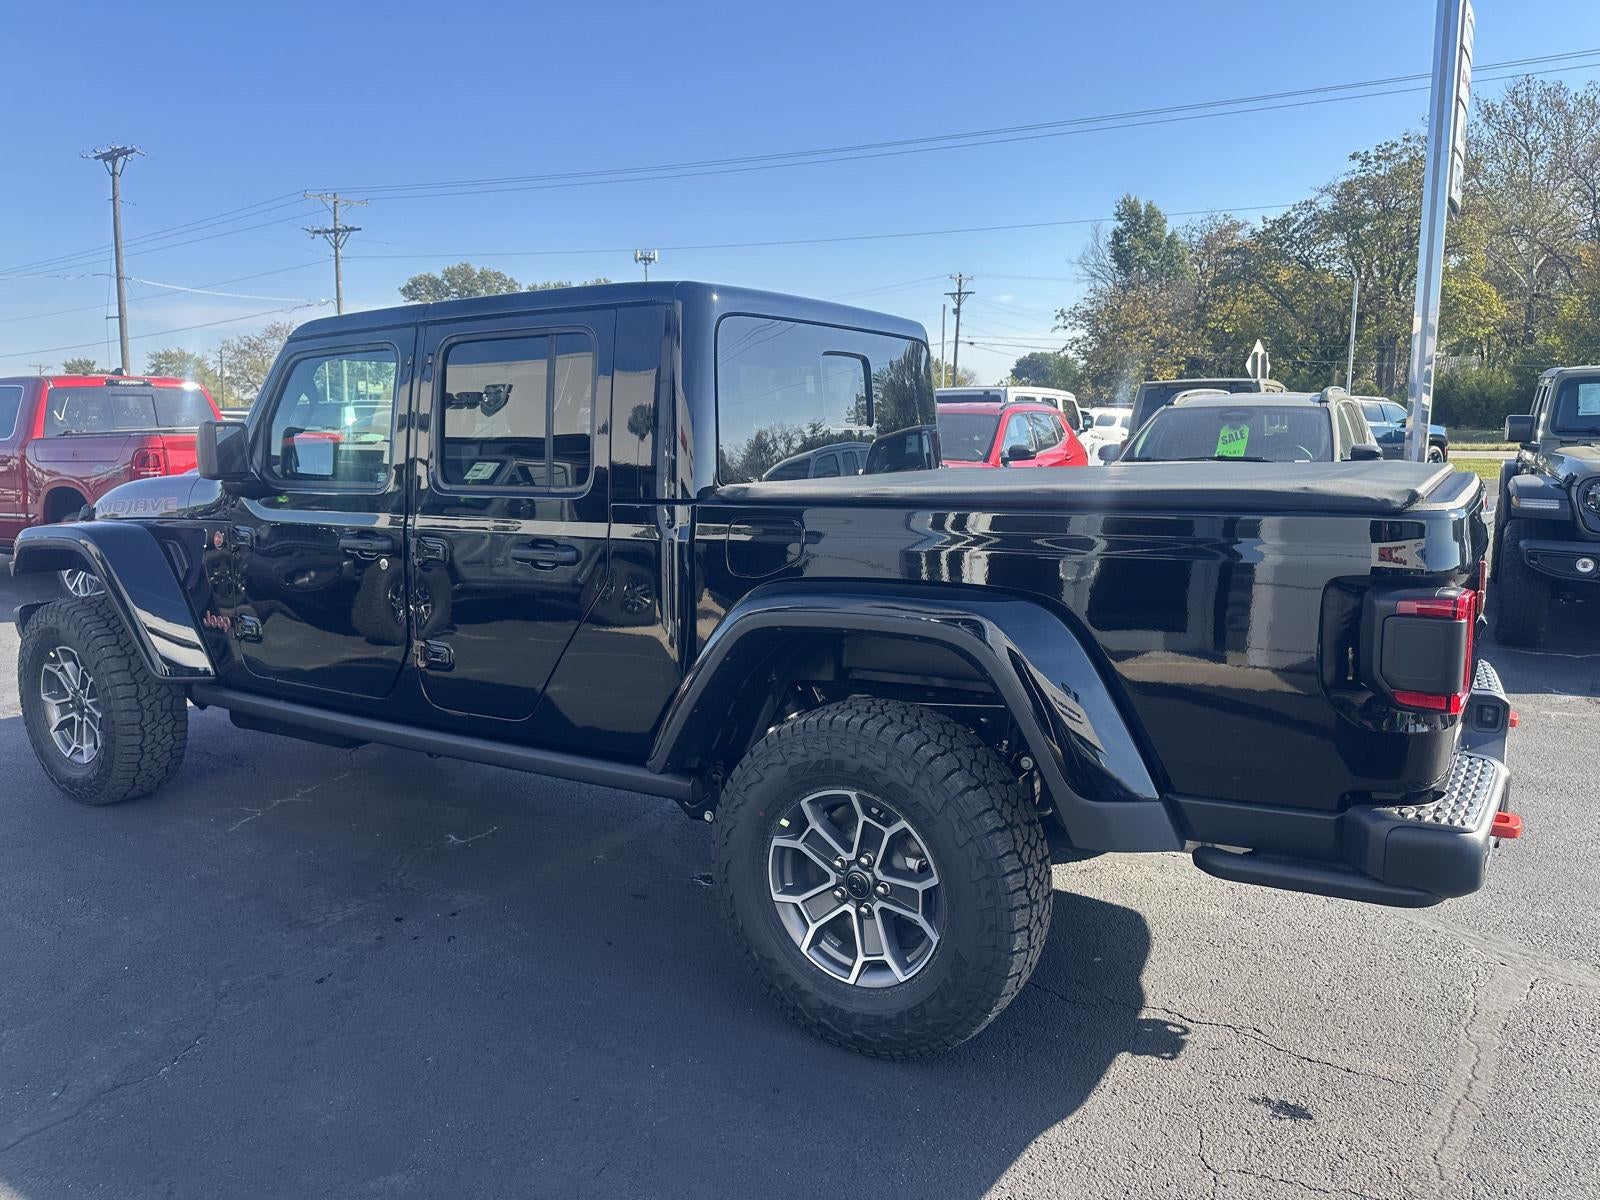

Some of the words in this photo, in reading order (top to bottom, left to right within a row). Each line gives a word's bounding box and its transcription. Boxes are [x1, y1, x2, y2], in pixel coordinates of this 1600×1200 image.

[1220, 430, 1246, 445] SALE
[96, 497, 178, 514] MOJAVE
[203, 609, 231, 632] Jeep
